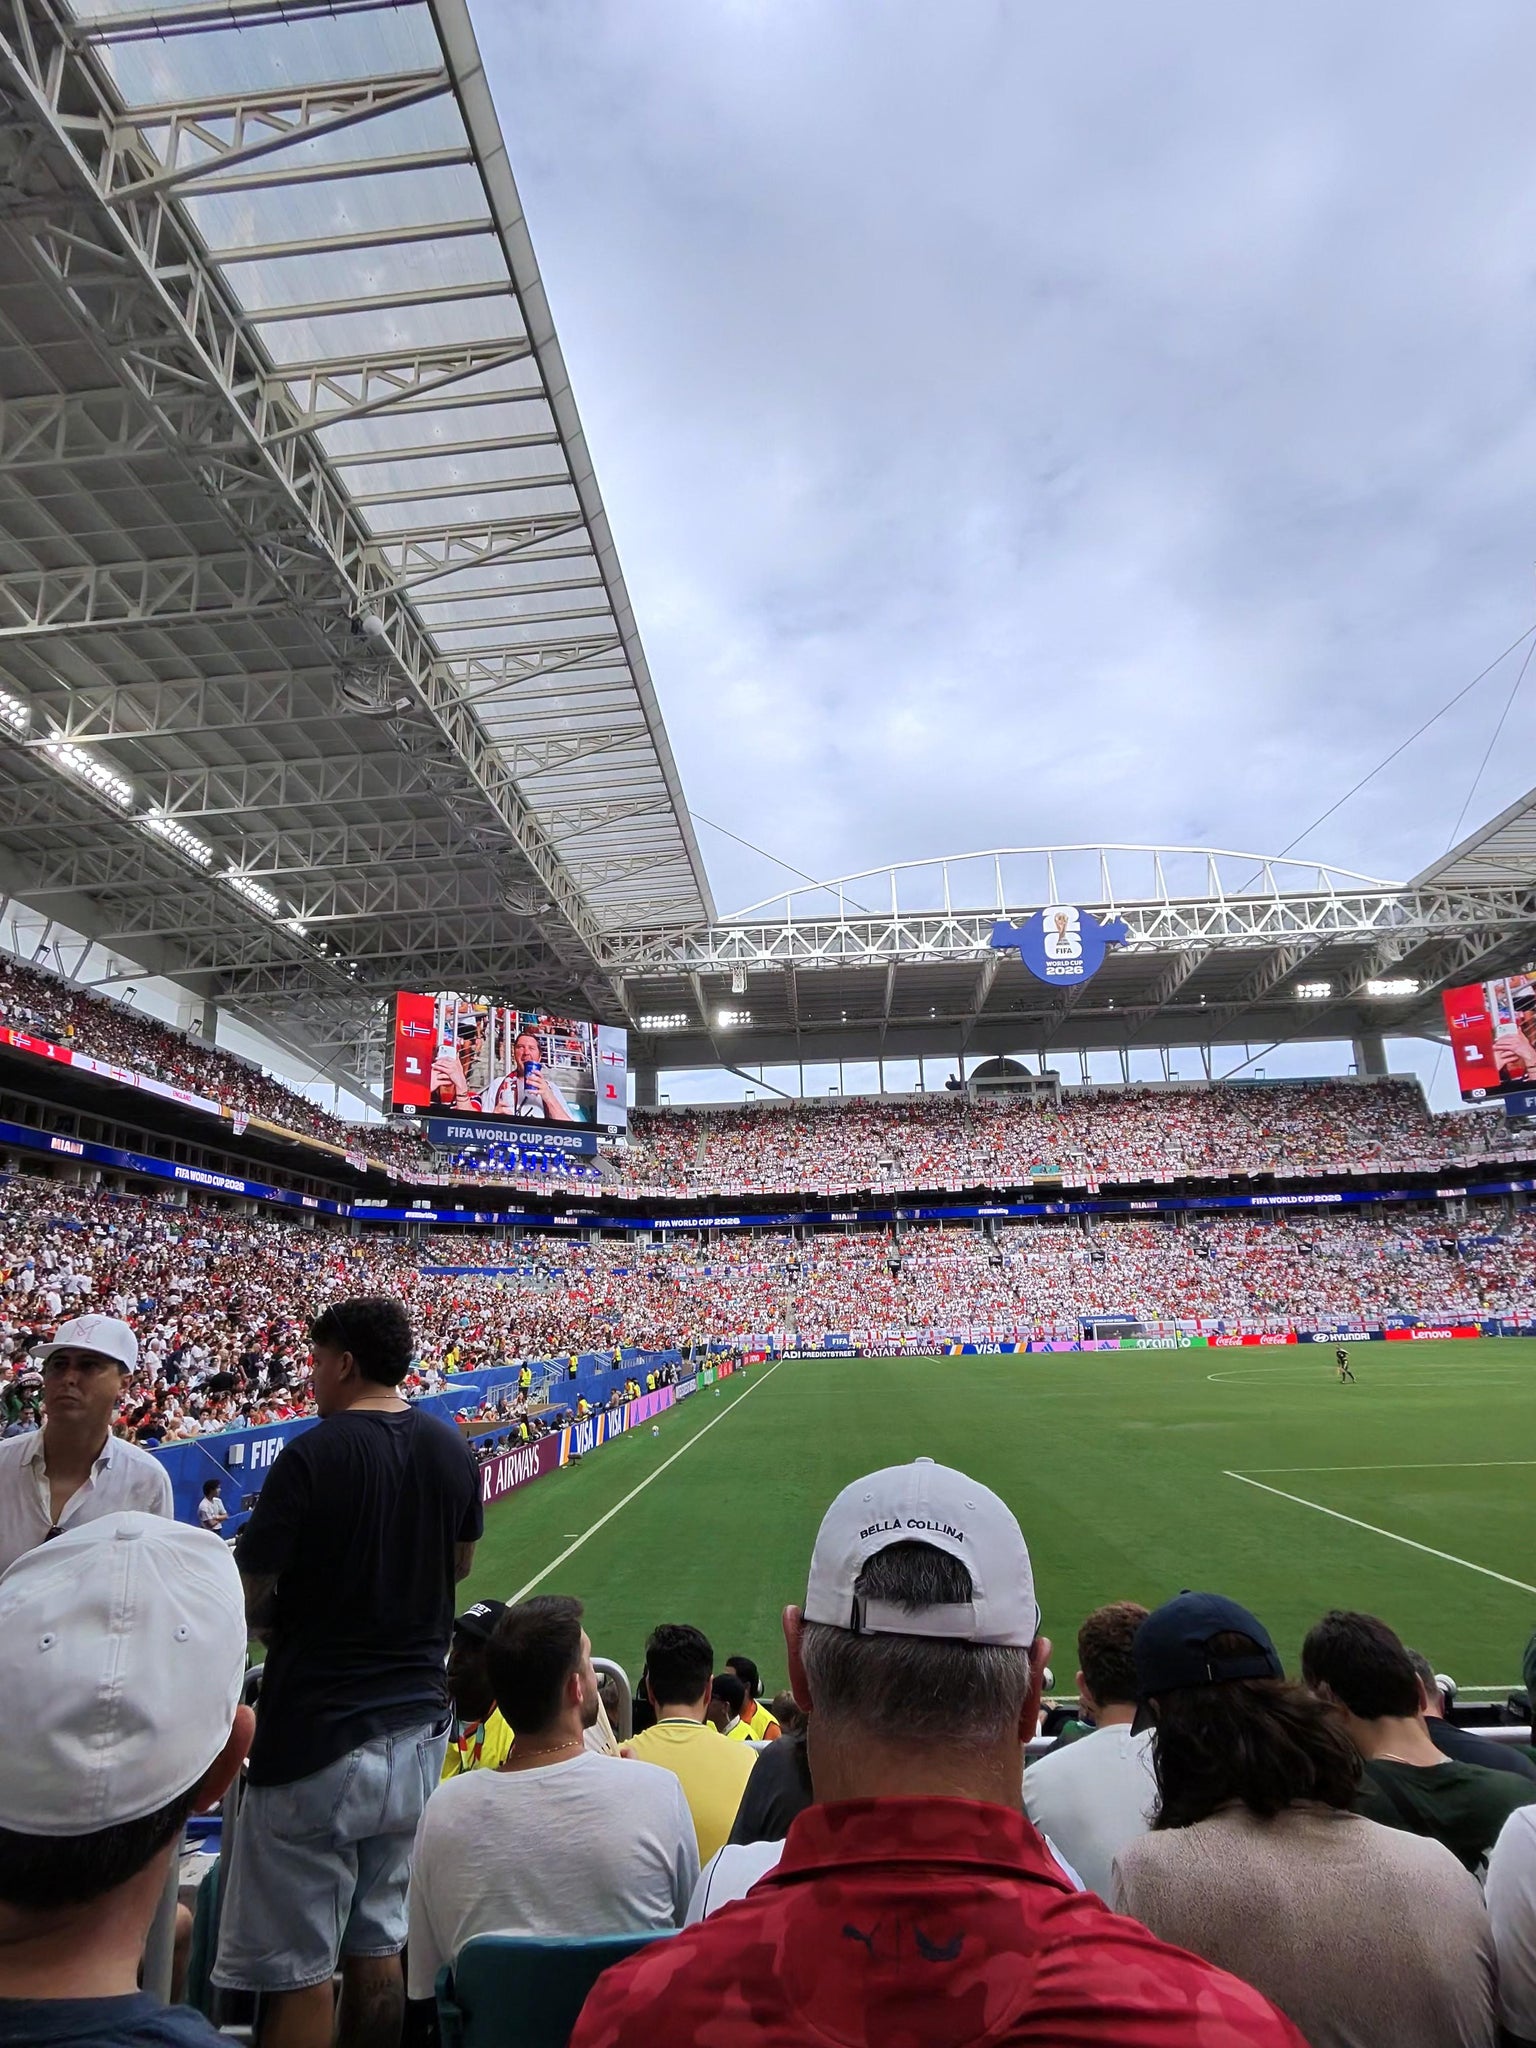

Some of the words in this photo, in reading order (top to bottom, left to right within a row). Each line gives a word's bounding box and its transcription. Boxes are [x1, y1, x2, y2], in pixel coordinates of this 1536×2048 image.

[1046, 966, 1084, 975] 2026
[47, 1045, 55, 1057] 1
[1464, 1045, 1484, 1061] 1
[91, 1061, 97, 1070] 1
[405, 1056, 422, 1074] 1
[173, 1090, 191, 1101] ENGLAND
[605, 1084, 617, 1099] 1
[447, 1126, 474, 1139] FIFA
[476, 1129, 517, 1143] WORLD
[519, 1132, 542, 1144] CUP
[543, 1134, 583, 1147] 2026
[51, 1137, 83, 1155] MIAMI
[175, 1167, 190, 1180] FIFA
[190, 1170, 212, 1185] WORLD
[213, 1175, 225, 1187] CUP
[224, 1179, 245, 1191] 2026
[1268, 1196, 1297, 1204] WORLD
[1298, 1195, 1314, 1203] CUP
[1313, 1194, 1342, 1202] 2026
[554, 1216, 578, 1224] MIAMI
[714, 1217, 740, 1225] 2026
[831, 1213, 858, 1221] MIAMI
[1330, 1332, 1371, 1341] HYUNDAI
[1411, 1330, 1453, 1339] Lenovo
[863, 1347, 897, 1357] QATAR
[899, 1346, 942, 1357] AIRWAYS
[975, 1344, 1002, 1354] VISA
[607, 1408, 621, 1438] VISA
[575, 1420, 593, 1453] VISA
[251, 1437, 284, 1470] FIFA
[495, 1444, 540, 1495] AIRWAYS
[860, 1519, 902, 1540] BELLA
[907, 1519, 965, 1543] COLLINA
